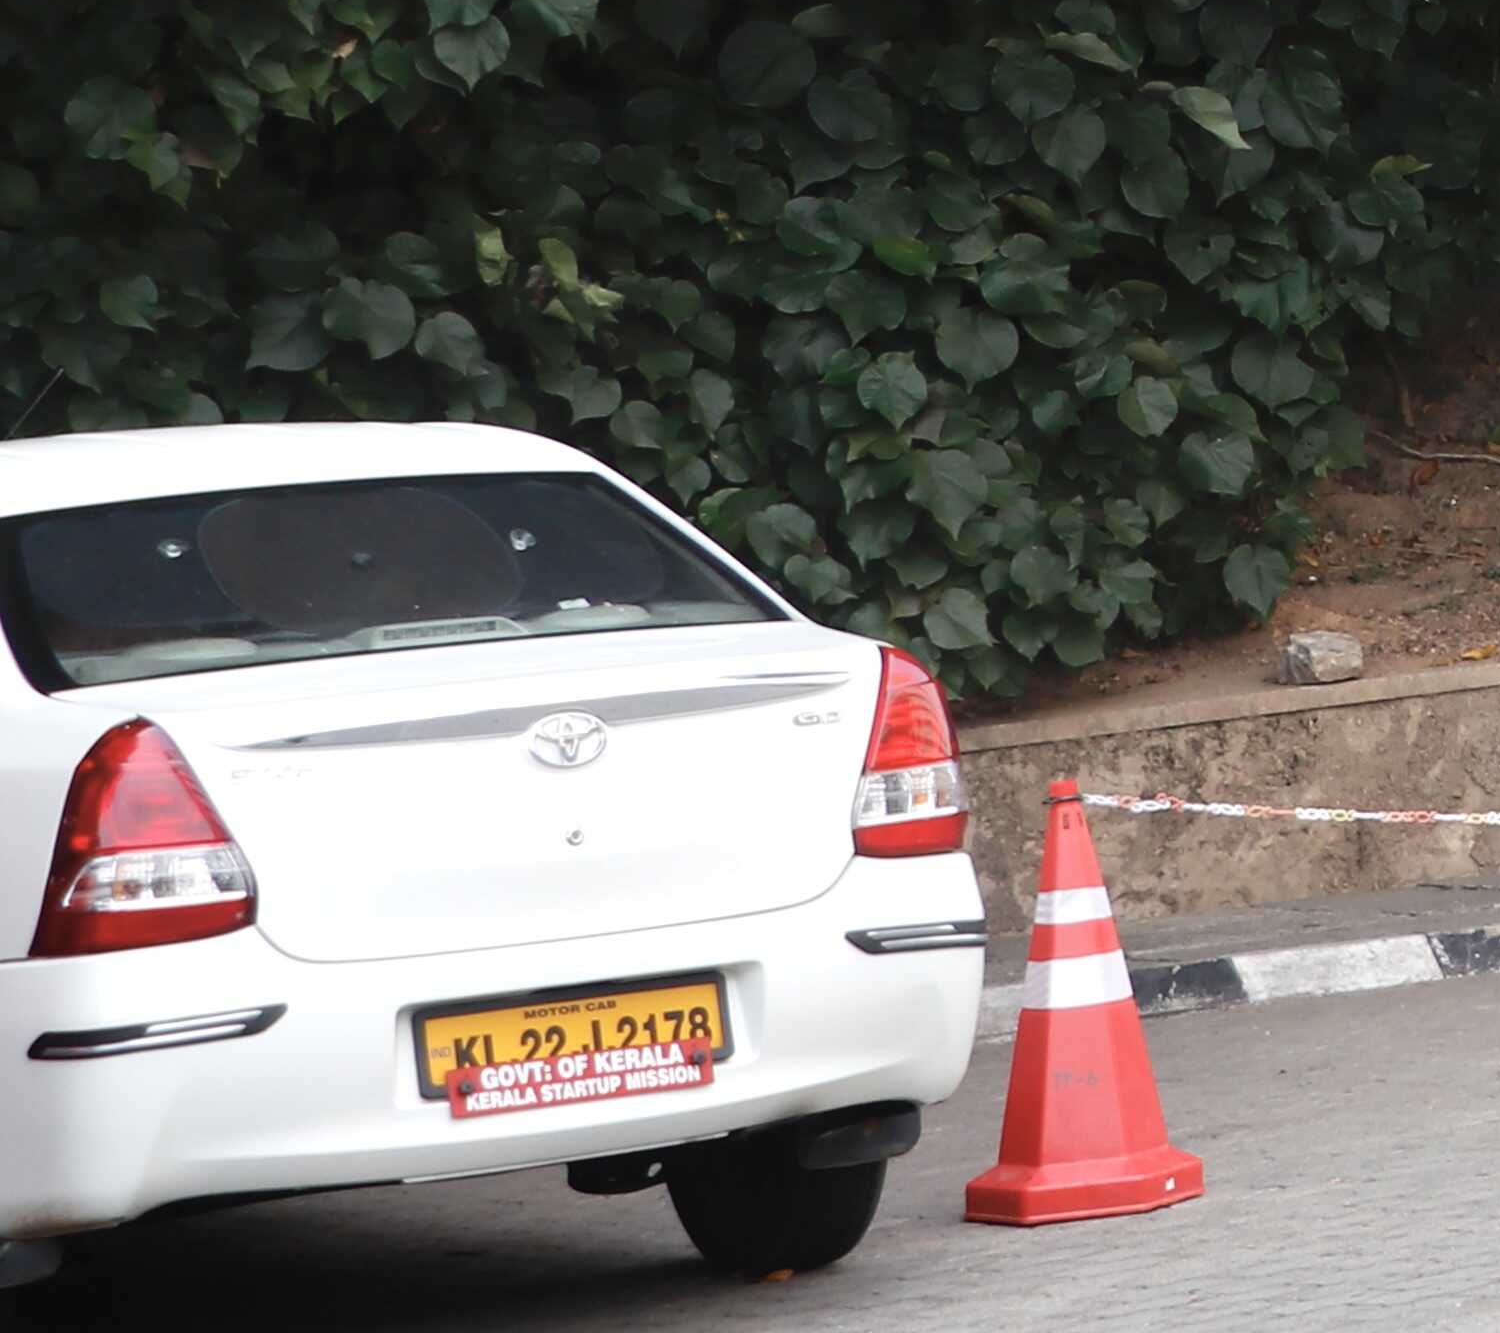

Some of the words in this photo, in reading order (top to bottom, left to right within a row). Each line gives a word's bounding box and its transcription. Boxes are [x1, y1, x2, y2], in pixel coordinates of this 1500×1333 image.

[524, 1002, 581, 1020] MOTOR
[586, 999, 617, 1012] CAB
[465, 1086, 538, 1111] KERALA
[541, 1076, 622, 1103] STARTUP
[625, 1065, 701, 1091] MISSION
[480, 1060, 552, 1089] GOVT:
[558, 1054, 589, 1078] OF
[595, 1042, 684, 1073] KERALA
